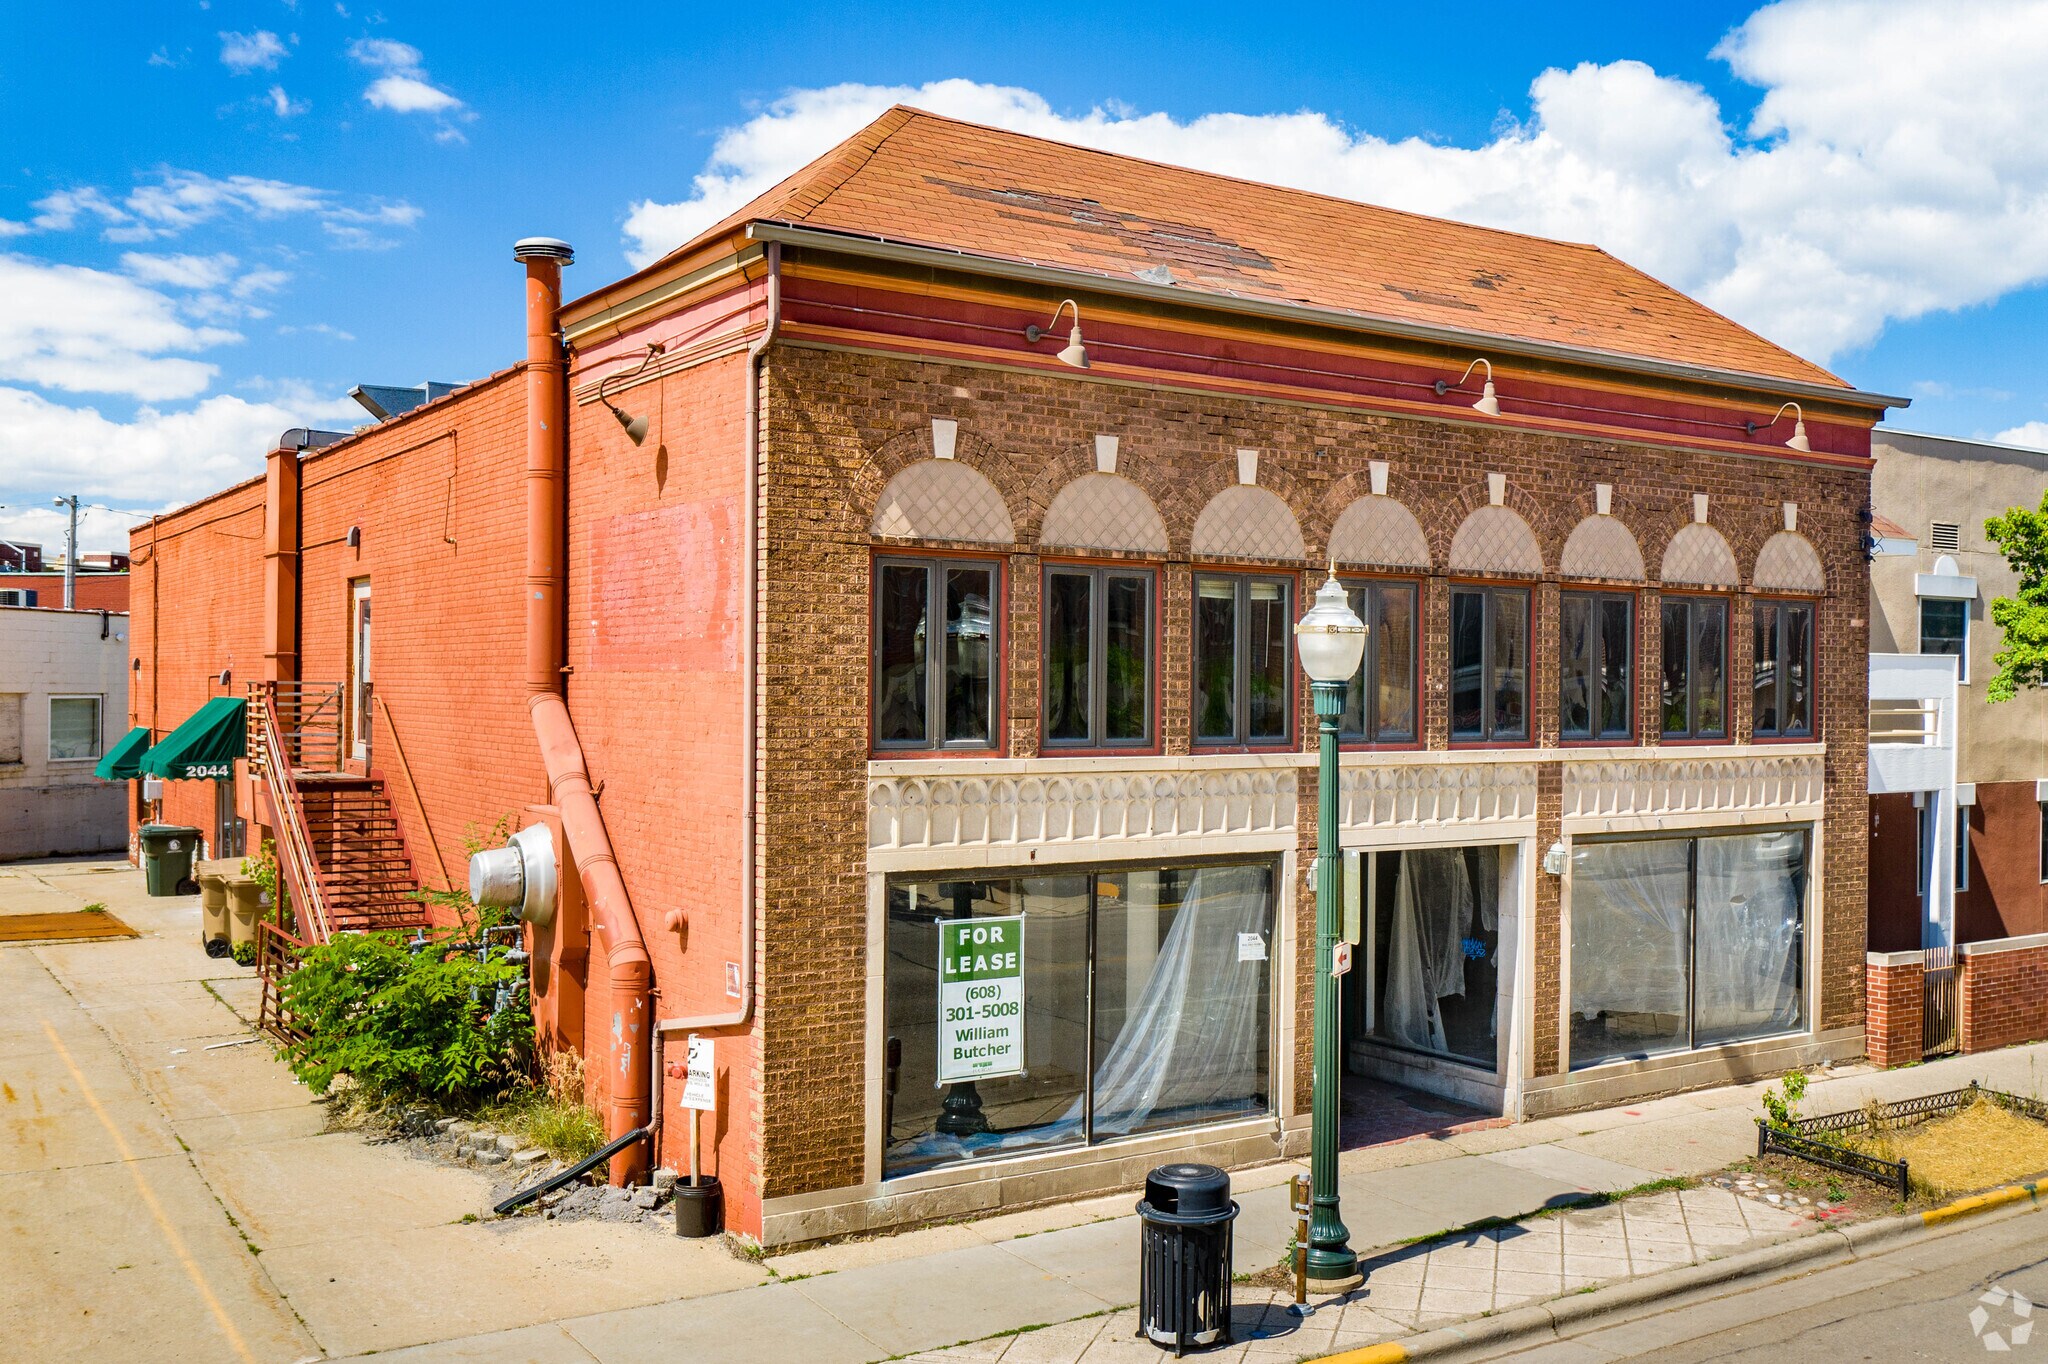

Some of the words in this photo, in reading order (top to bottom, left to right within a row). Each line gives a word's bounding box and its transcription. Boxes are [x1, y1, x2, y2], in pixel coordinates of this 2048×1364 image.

[185, 764, 229, 777] 2044
[959, 926, 1005, 946] FOR
[945, 952, 1017, 974] LEASE
[965, 984, 1002, 1003] (608)
[945, 1001, 1019, 1022] 301-5008
[955, 1026, 1009, 1042] William
[953, 1043, 1012, 1060] Butcher
[688, 1069, 711, 1079] ARKING
